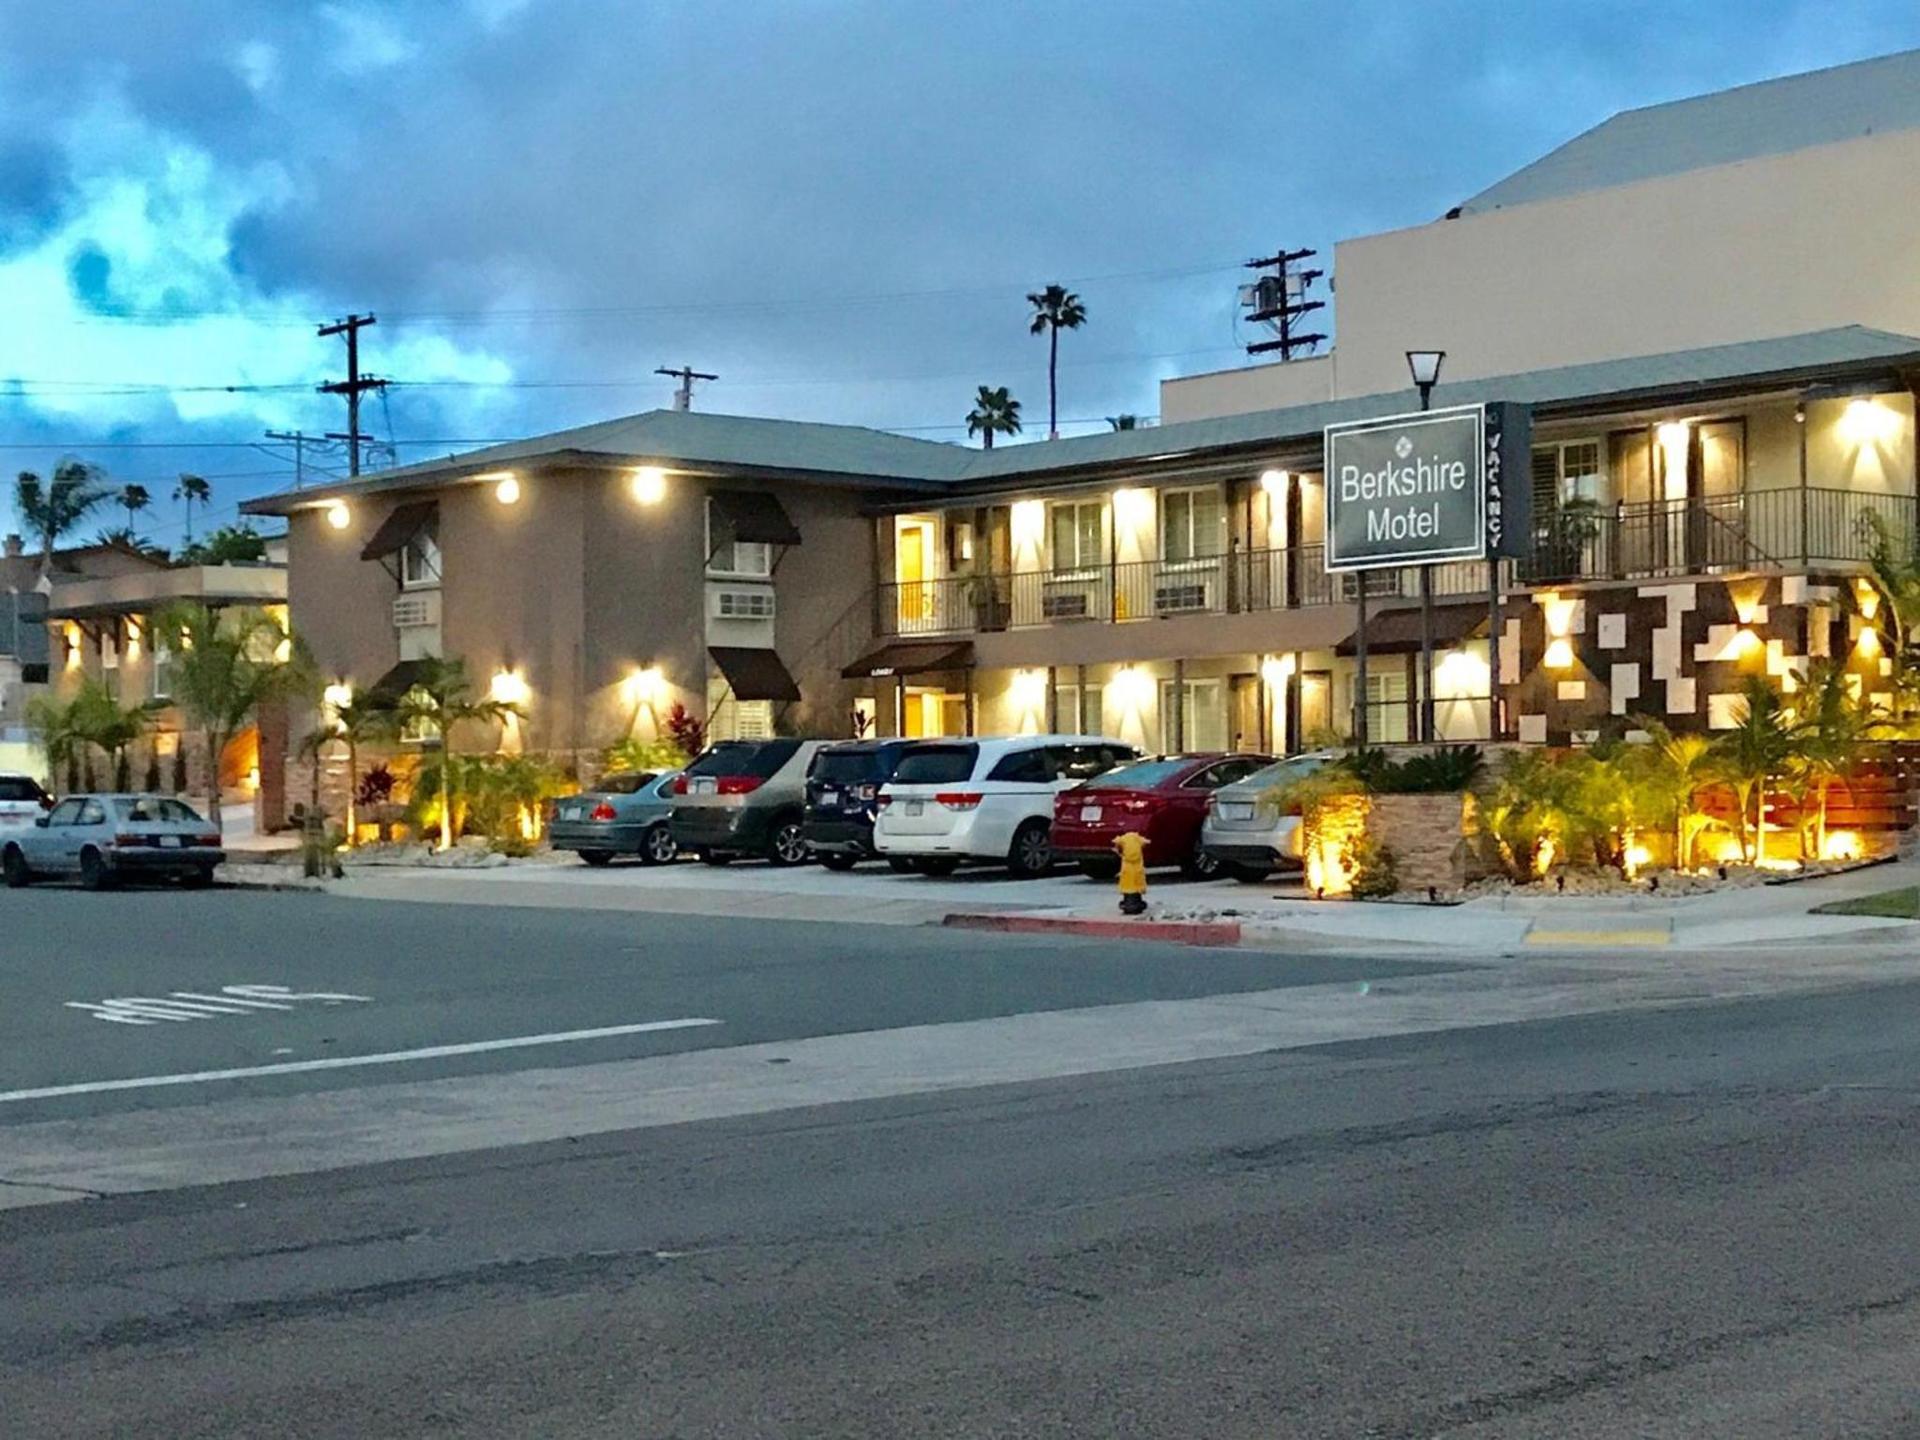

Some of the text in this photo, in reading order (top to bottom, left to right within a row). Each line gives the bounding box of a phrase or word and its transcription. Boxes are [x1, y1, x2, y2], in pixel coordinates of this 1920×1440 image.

[1341, 455, 1466, 502] Berkshire
[1487, 432, 1501, 548] VACANCY
[1367, 502, 1440, 542] Motel
